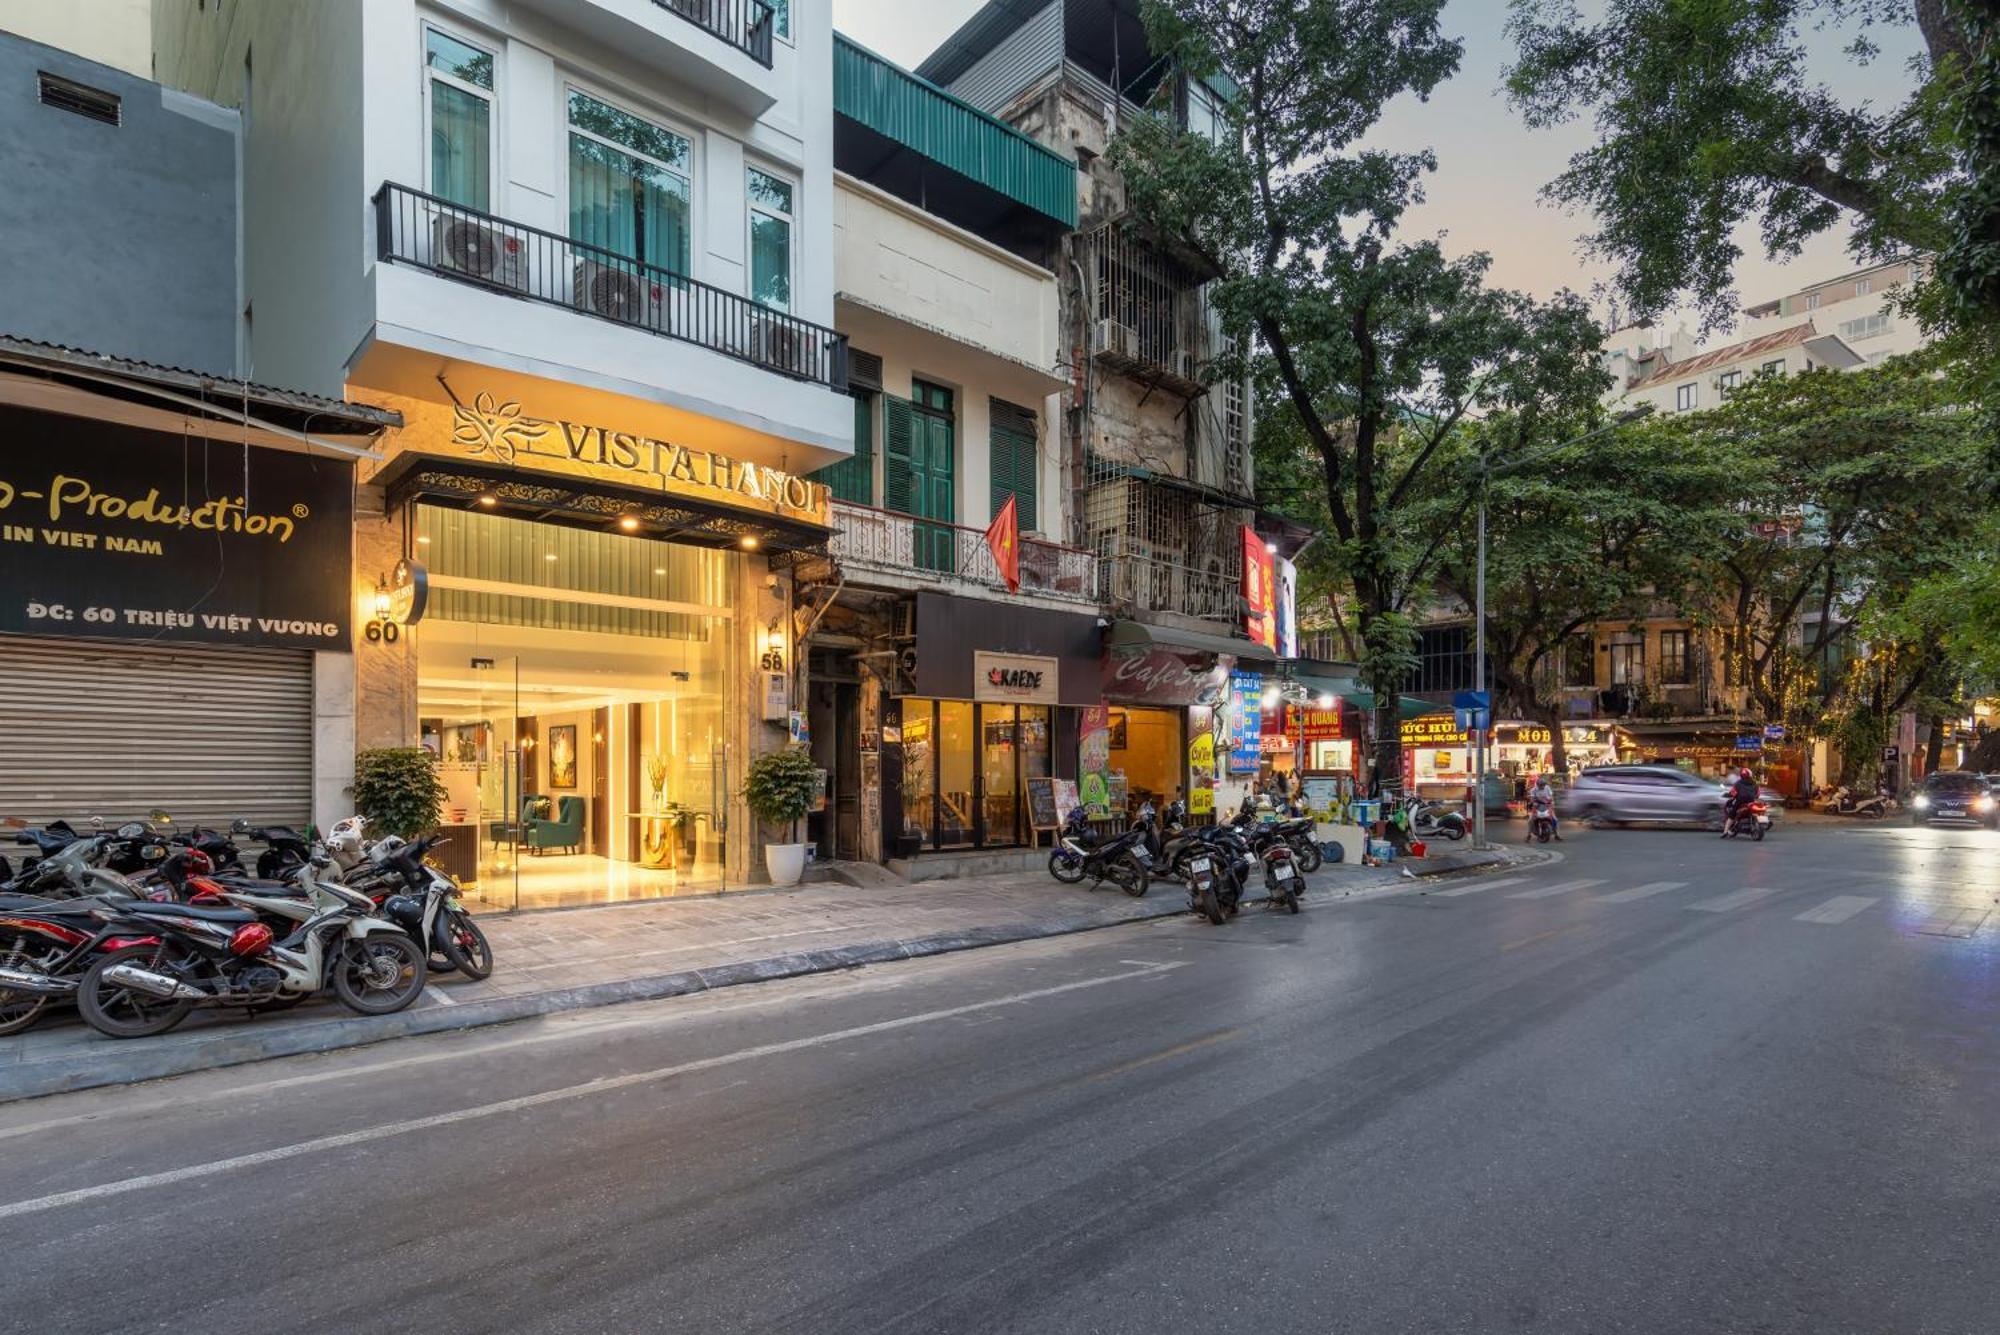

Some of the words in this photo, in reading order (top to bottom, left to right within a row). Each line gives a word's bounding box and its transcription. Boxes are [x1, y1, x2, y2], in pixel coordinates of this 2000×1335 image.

[556, 420, 699, 484] VISTA
[705, 452, 818, 513] HANOI
[3, 525, 34, 543] IN
[41, 528, 97, 549] VIET
[105, 535, 163, 555] NAM
[26, 602, 74, 621] ĐC:
[82, 607, 116, 623] 60
[123, 609, 194, 630] TRIỆU
[201, 613, 252, 633] VIỆT
[256, 618, 339, 637] VƯƠNG
[365, 620, 399, 643] 60
[761, 652, 783, 670] 58
[1000, 668, 1044, 688] KAEDE
[1115, 656, 1174, 692] Cafe
[1312, 712, 1338, 726] QUANG
[1578, 730, 1597, 742] 24
[1884, 748, 1896, 759] P
